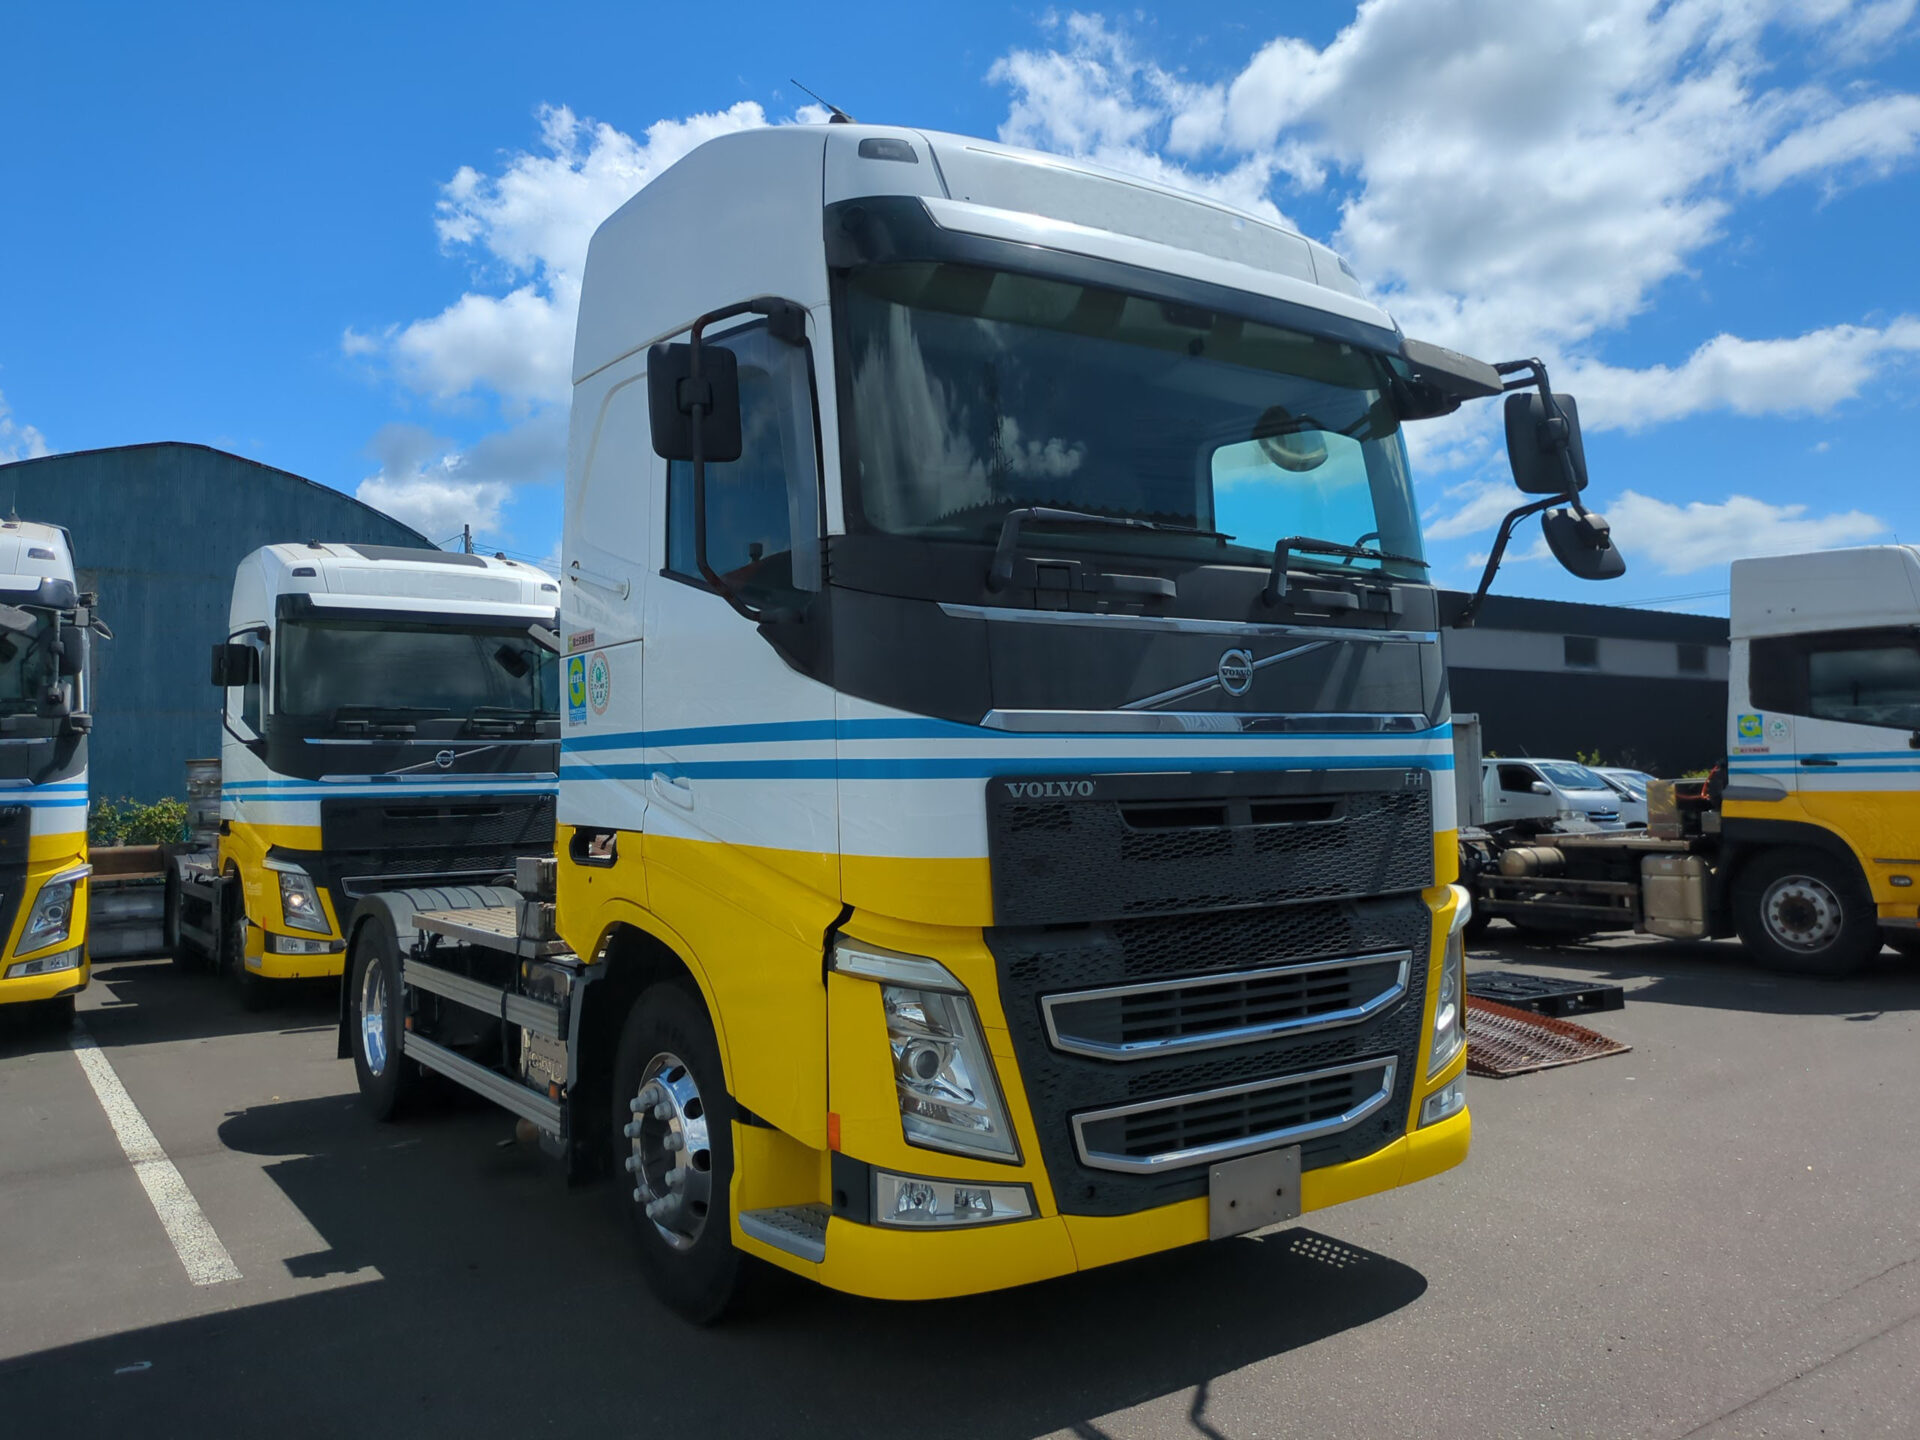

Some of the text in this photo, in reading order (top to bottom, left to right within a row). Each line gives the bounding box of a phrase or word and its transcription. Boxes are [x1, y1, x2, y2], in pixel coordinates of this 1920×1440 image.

[1221, 668, 1251, 678] VOLVO
[1405, 773, 1423, 785] FH
[1004, 780, 1094, 798] VOLVO
